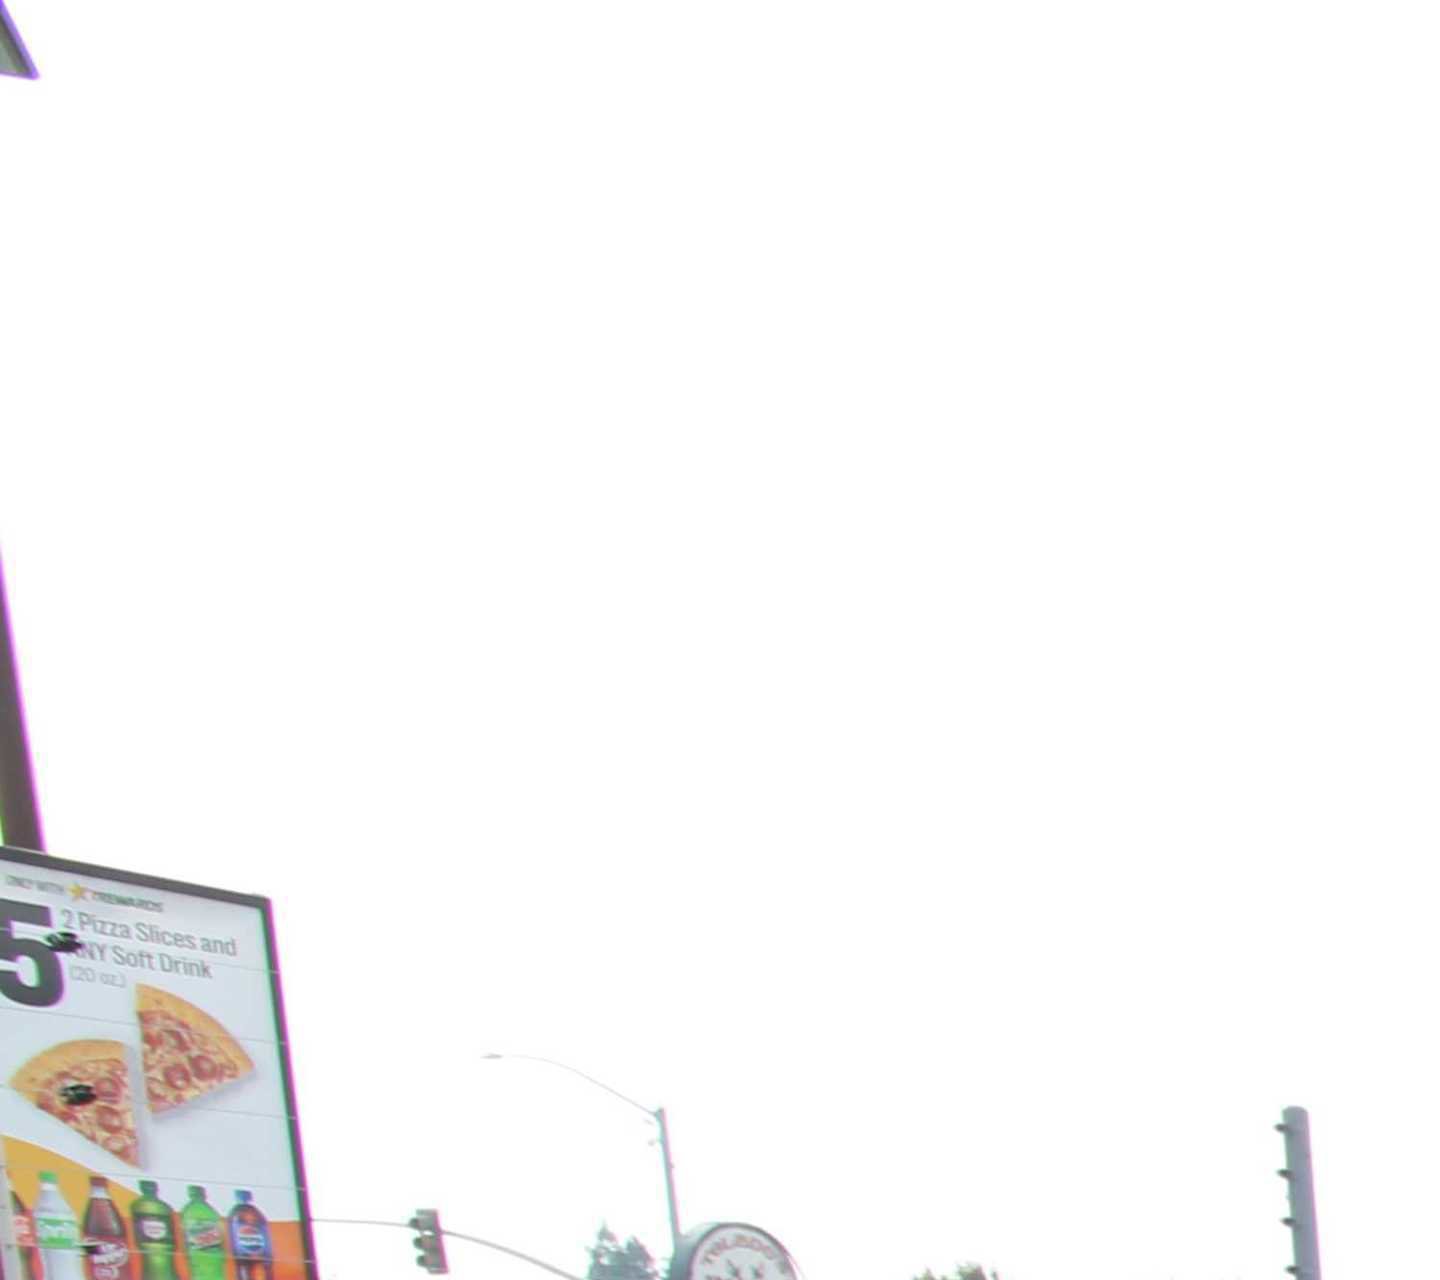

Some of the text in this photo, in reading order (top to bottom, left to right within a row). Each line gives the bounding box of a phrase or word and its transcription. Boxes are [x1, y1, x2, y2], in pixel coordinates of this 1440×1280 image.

[61, 909, 237, 957] 2 Pizza Slices and
[112, 946, 155, 971] Soft
[159, 952, 213, 979] Drink
